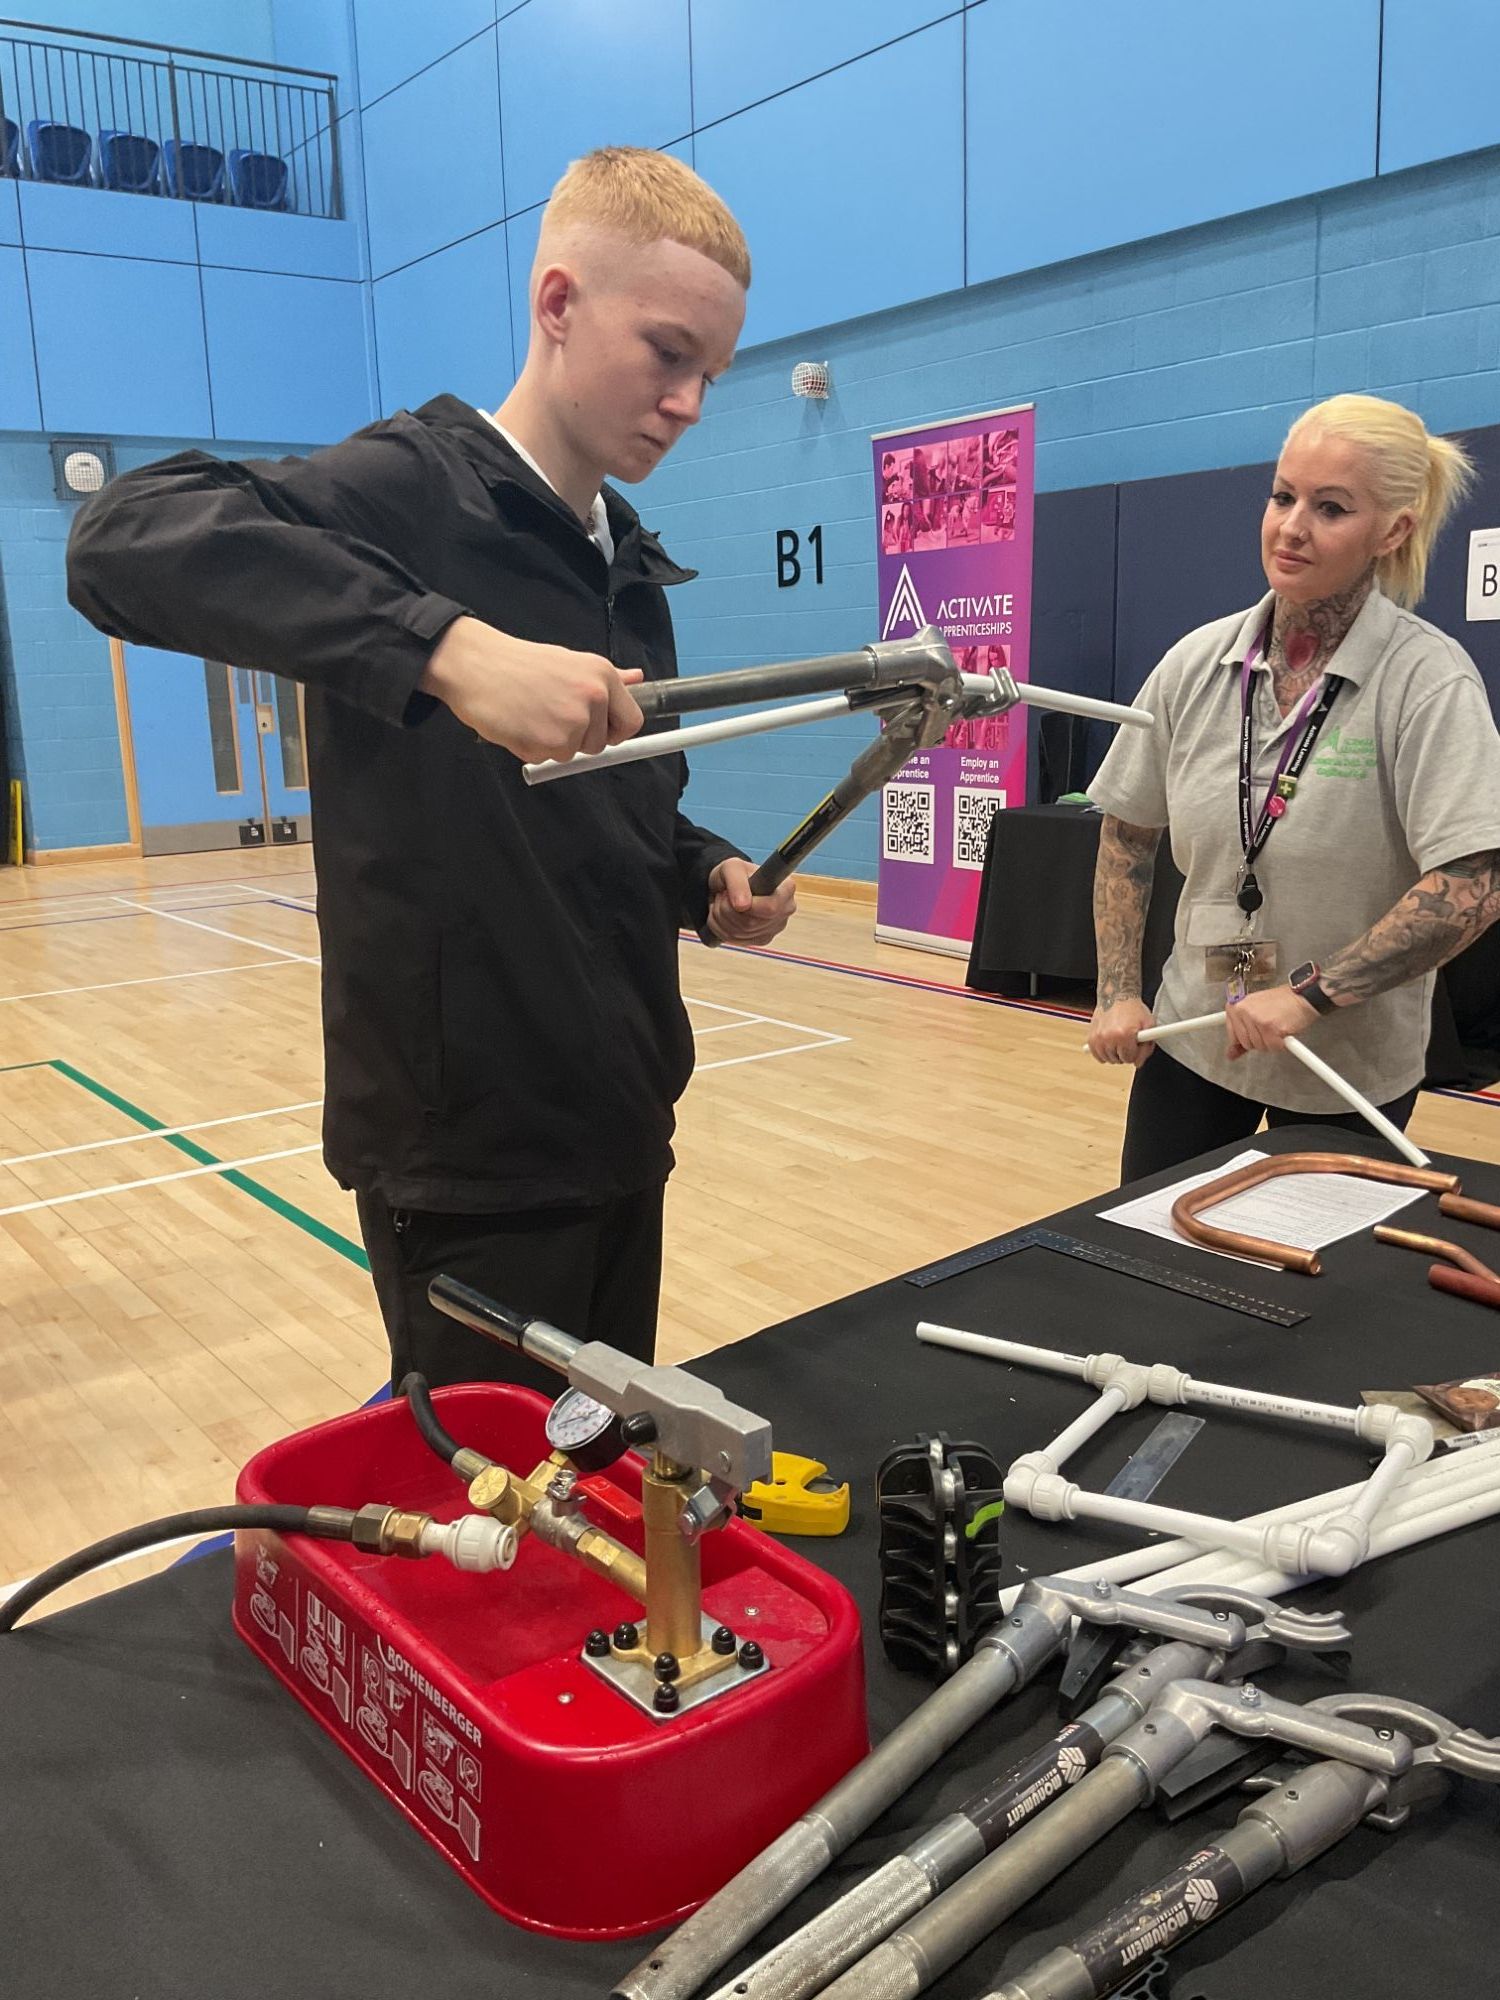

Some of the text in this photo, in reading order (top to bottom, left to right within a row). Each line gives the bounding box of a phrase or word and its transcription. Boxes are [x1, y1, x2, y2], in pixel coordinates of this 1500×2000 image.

[776, 525, 824, 588] B1
[936, 594, 1013, 619] ACTIVATE
[938, 622, 1012, 637] PPRENTICESHIPS
[960, 771, 999, 784] Apprentice
[961, 757, 999, 771] Employ an
[385, 1645, 482, 1749] ROTHENBERGER
[1006, 1774, 1063, 1828] MONUMENT
[1120, 1909, 1189, 1967] MONUMENT
